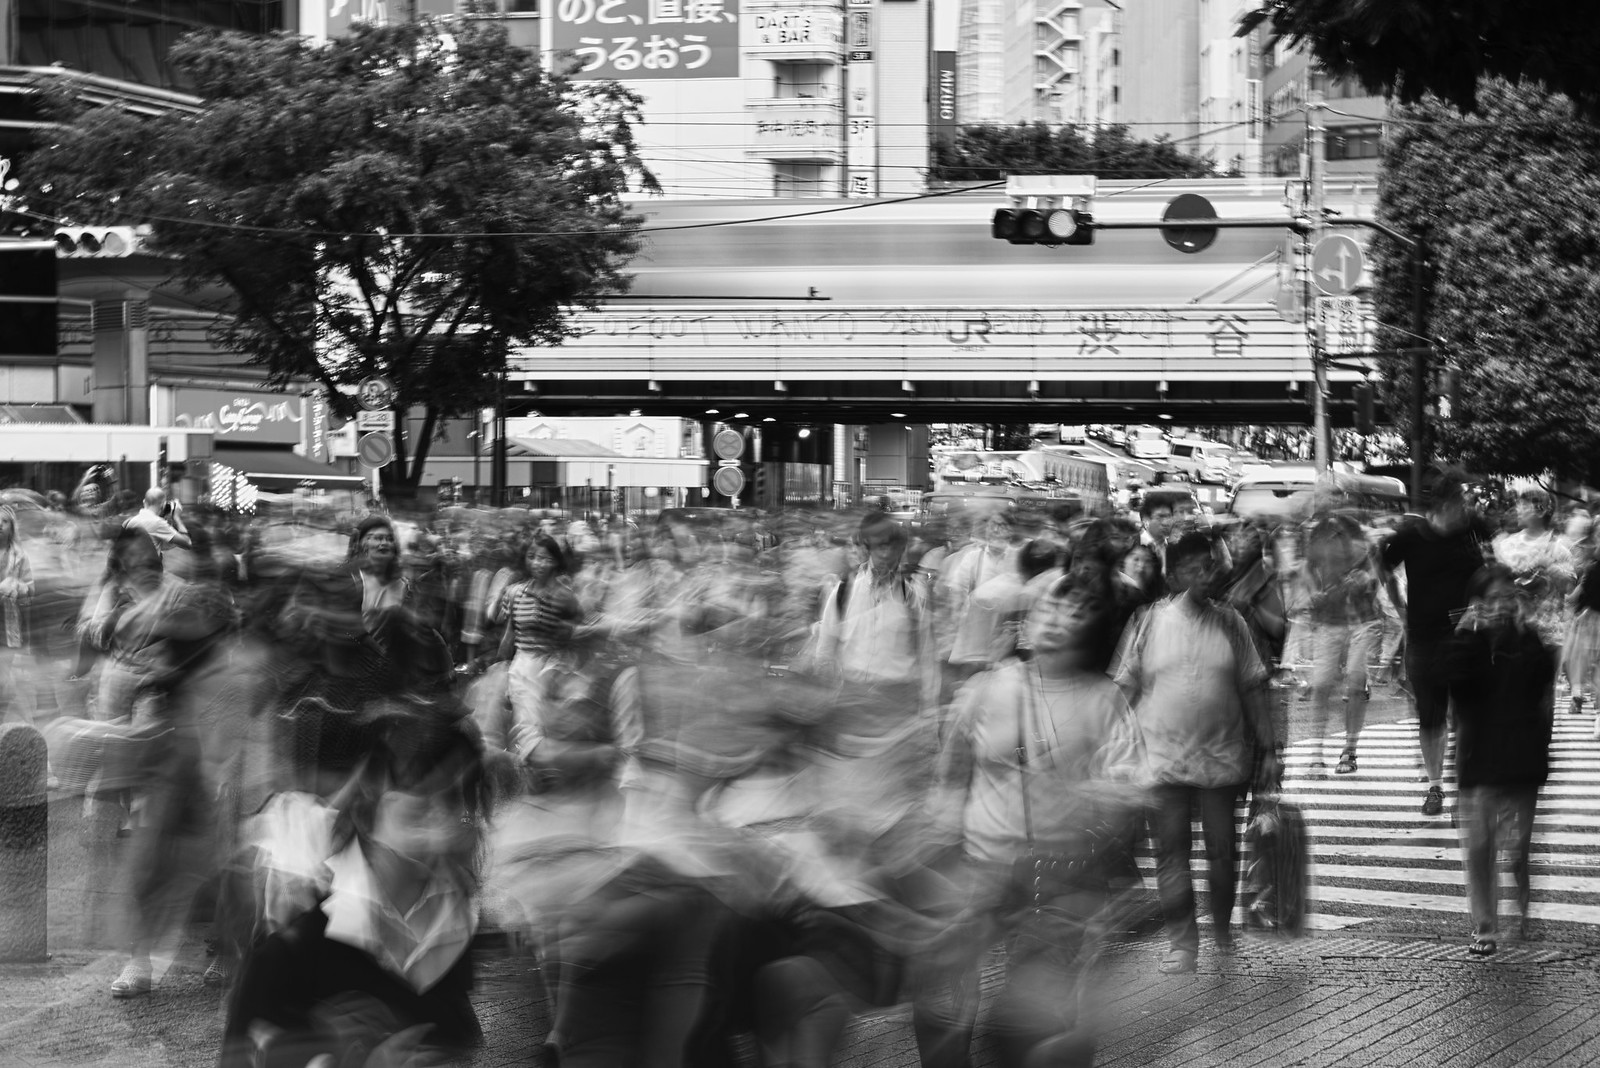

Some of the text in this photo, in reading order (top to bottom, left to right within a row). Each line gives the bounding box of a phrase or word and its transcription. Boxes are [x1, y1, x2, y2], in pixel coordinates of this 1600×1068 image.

[755, 15, 812, 29] DARTS
[779, 29, 812, 43] BAR
[575, 34, 712, 72] うるおう
